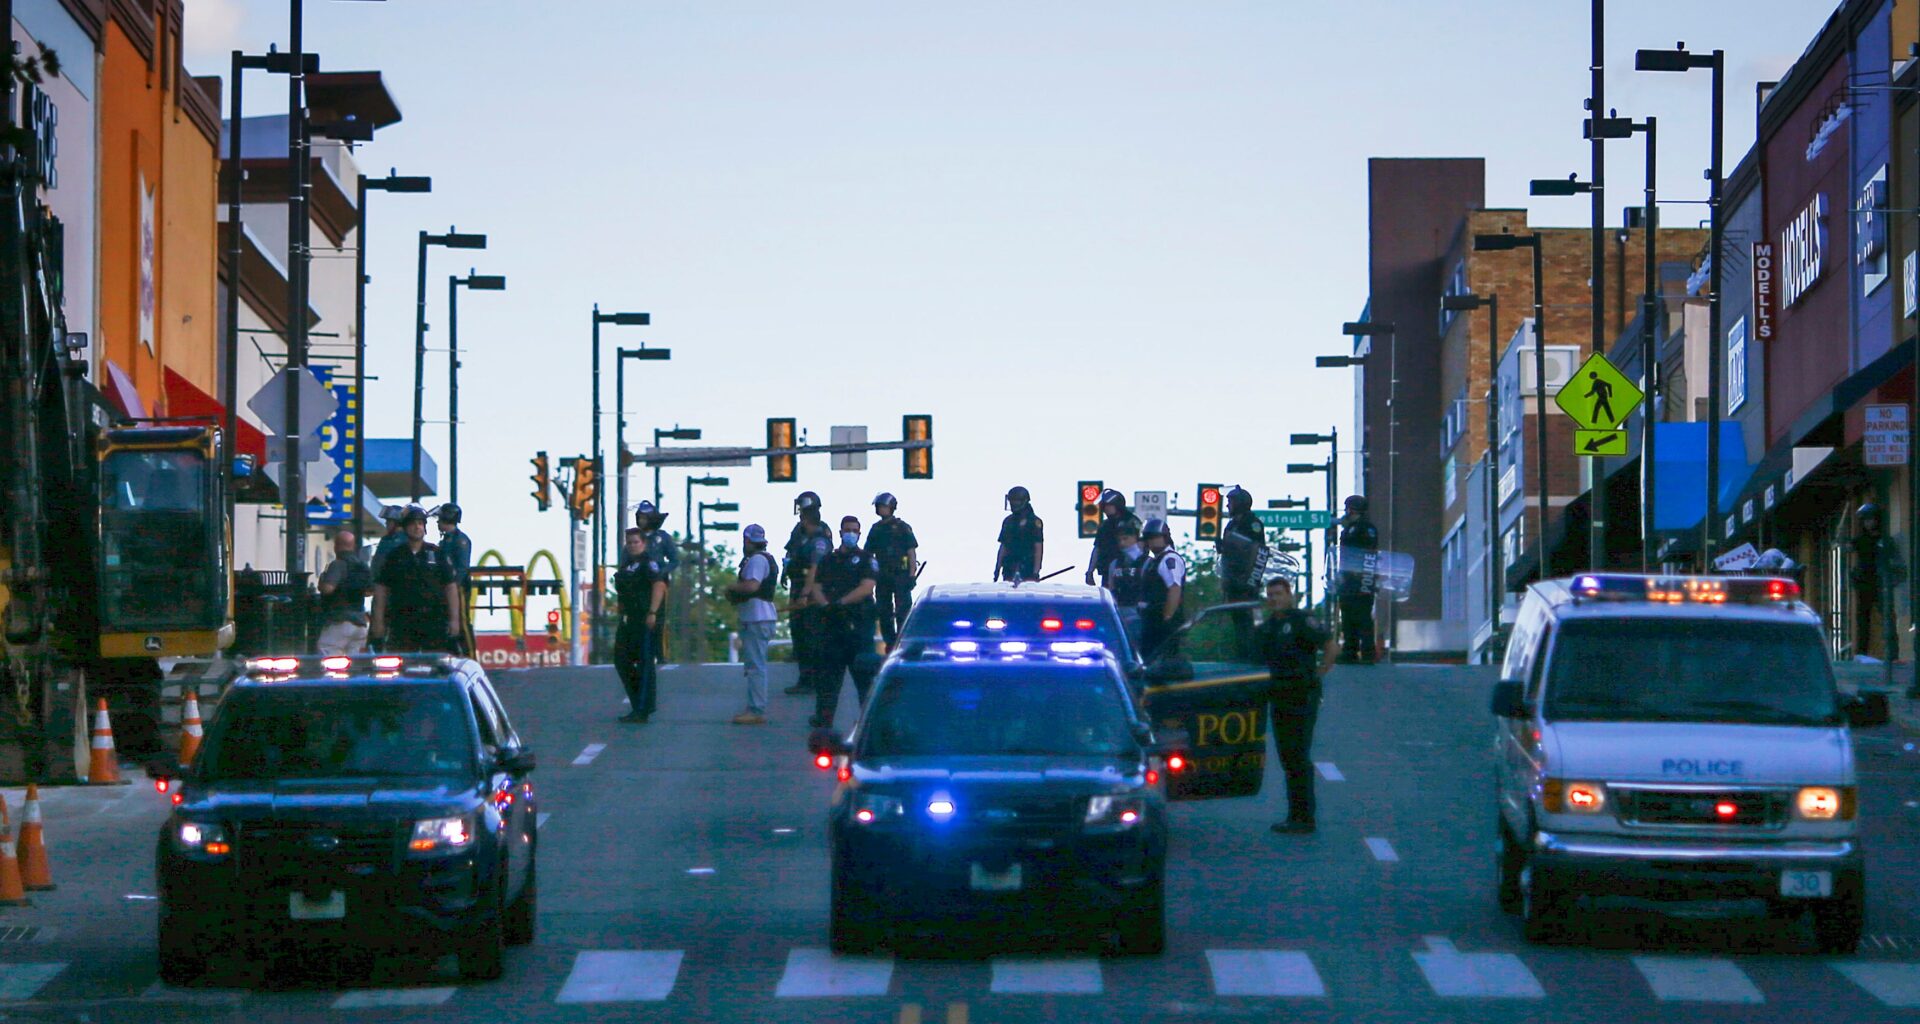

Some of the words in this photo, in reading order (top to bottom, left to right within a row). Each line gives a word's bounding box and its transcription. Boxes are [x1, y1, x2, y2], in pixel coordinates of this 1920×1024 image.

[1781, 192, 1823, 310] MODELL'S
[1755, 244, 1772, 338] MODELL'S
[1879, 408, 1893, 419] NO
[1866, 421, 1906, 431] PARKING
[1142, 494, 1160, 503] NO
[1259, 513, 1303, 524] estnut
[1311, 514, 1325, 523] St
[1247, 547, 1270, 587] POLICE
[1361, 553, 1377, 593] POLICE
[1196, 709, 1266, 747] POL
[1662, 758, 1744, 776] POLICE
[1791, 874, 1821, 892] 30
